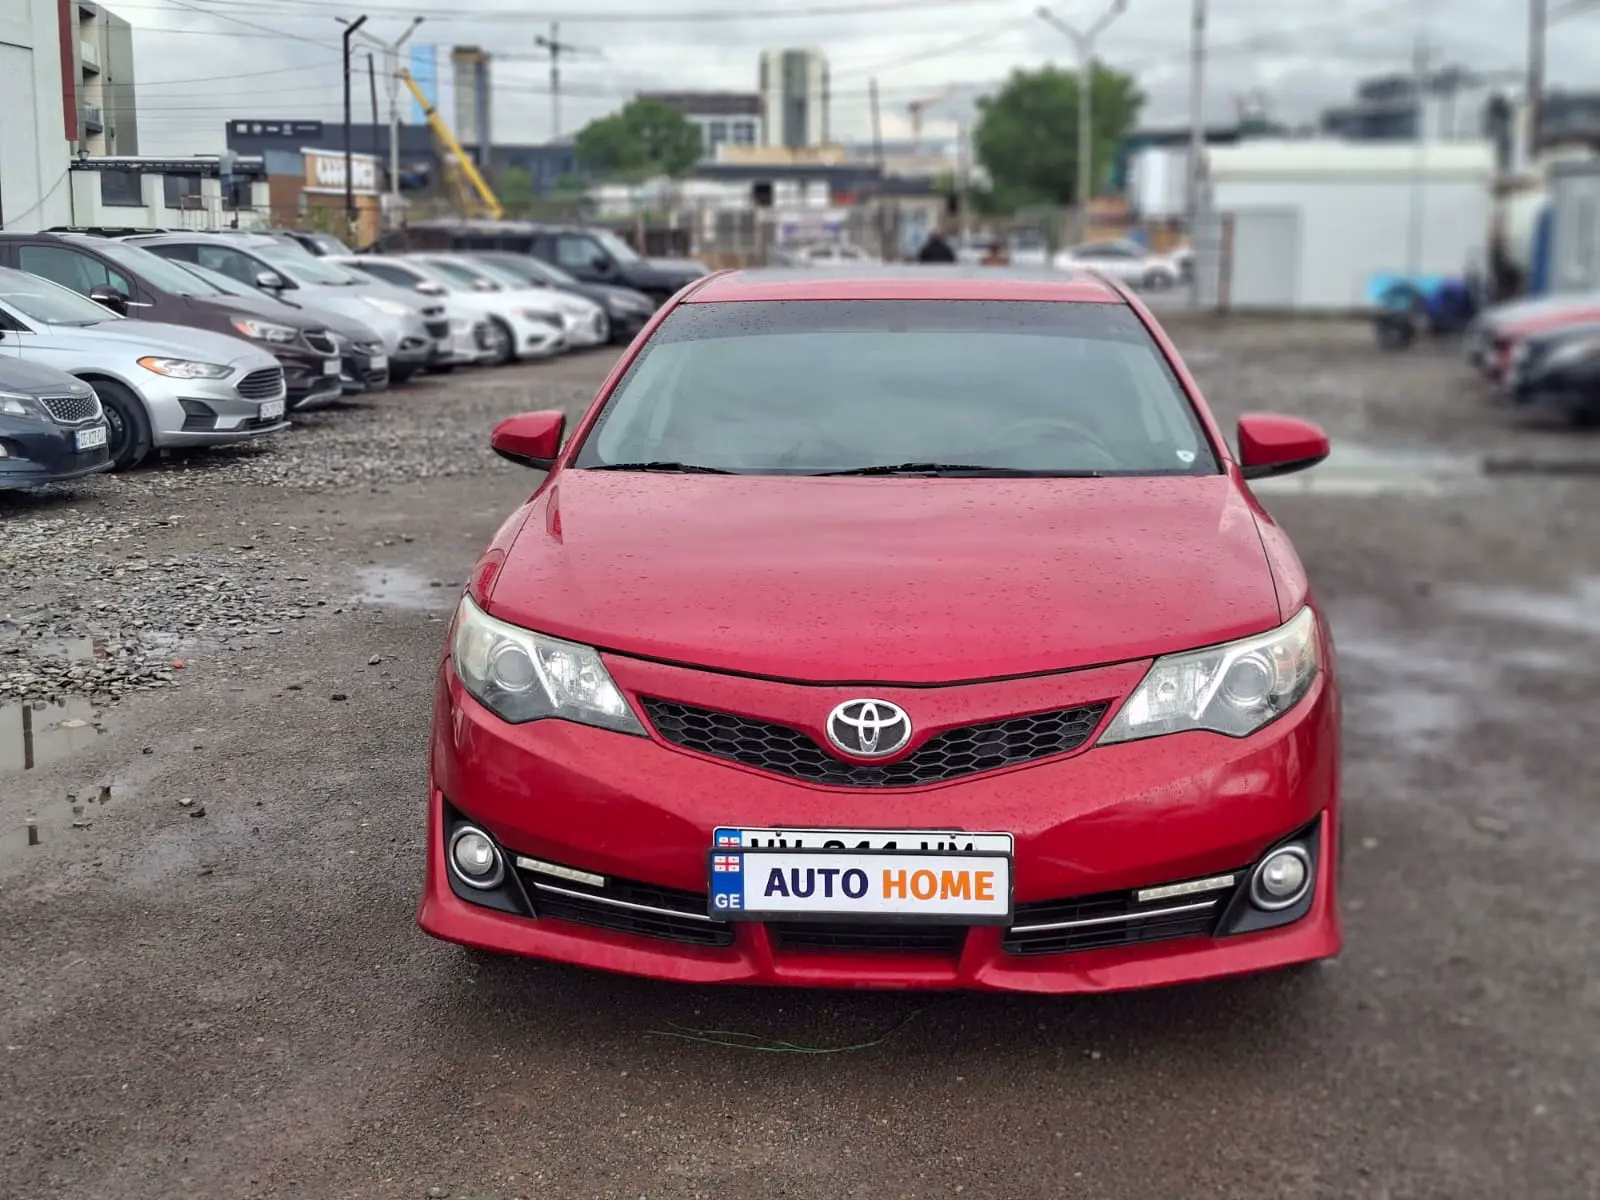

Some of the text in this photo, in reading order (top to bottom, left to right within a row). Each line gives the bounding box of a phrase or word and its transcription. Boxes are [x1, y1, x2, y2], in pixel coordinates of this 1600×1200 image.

[764, 868, 994, 901] AUTO HOME
[715, 893, 741, 909] GE
